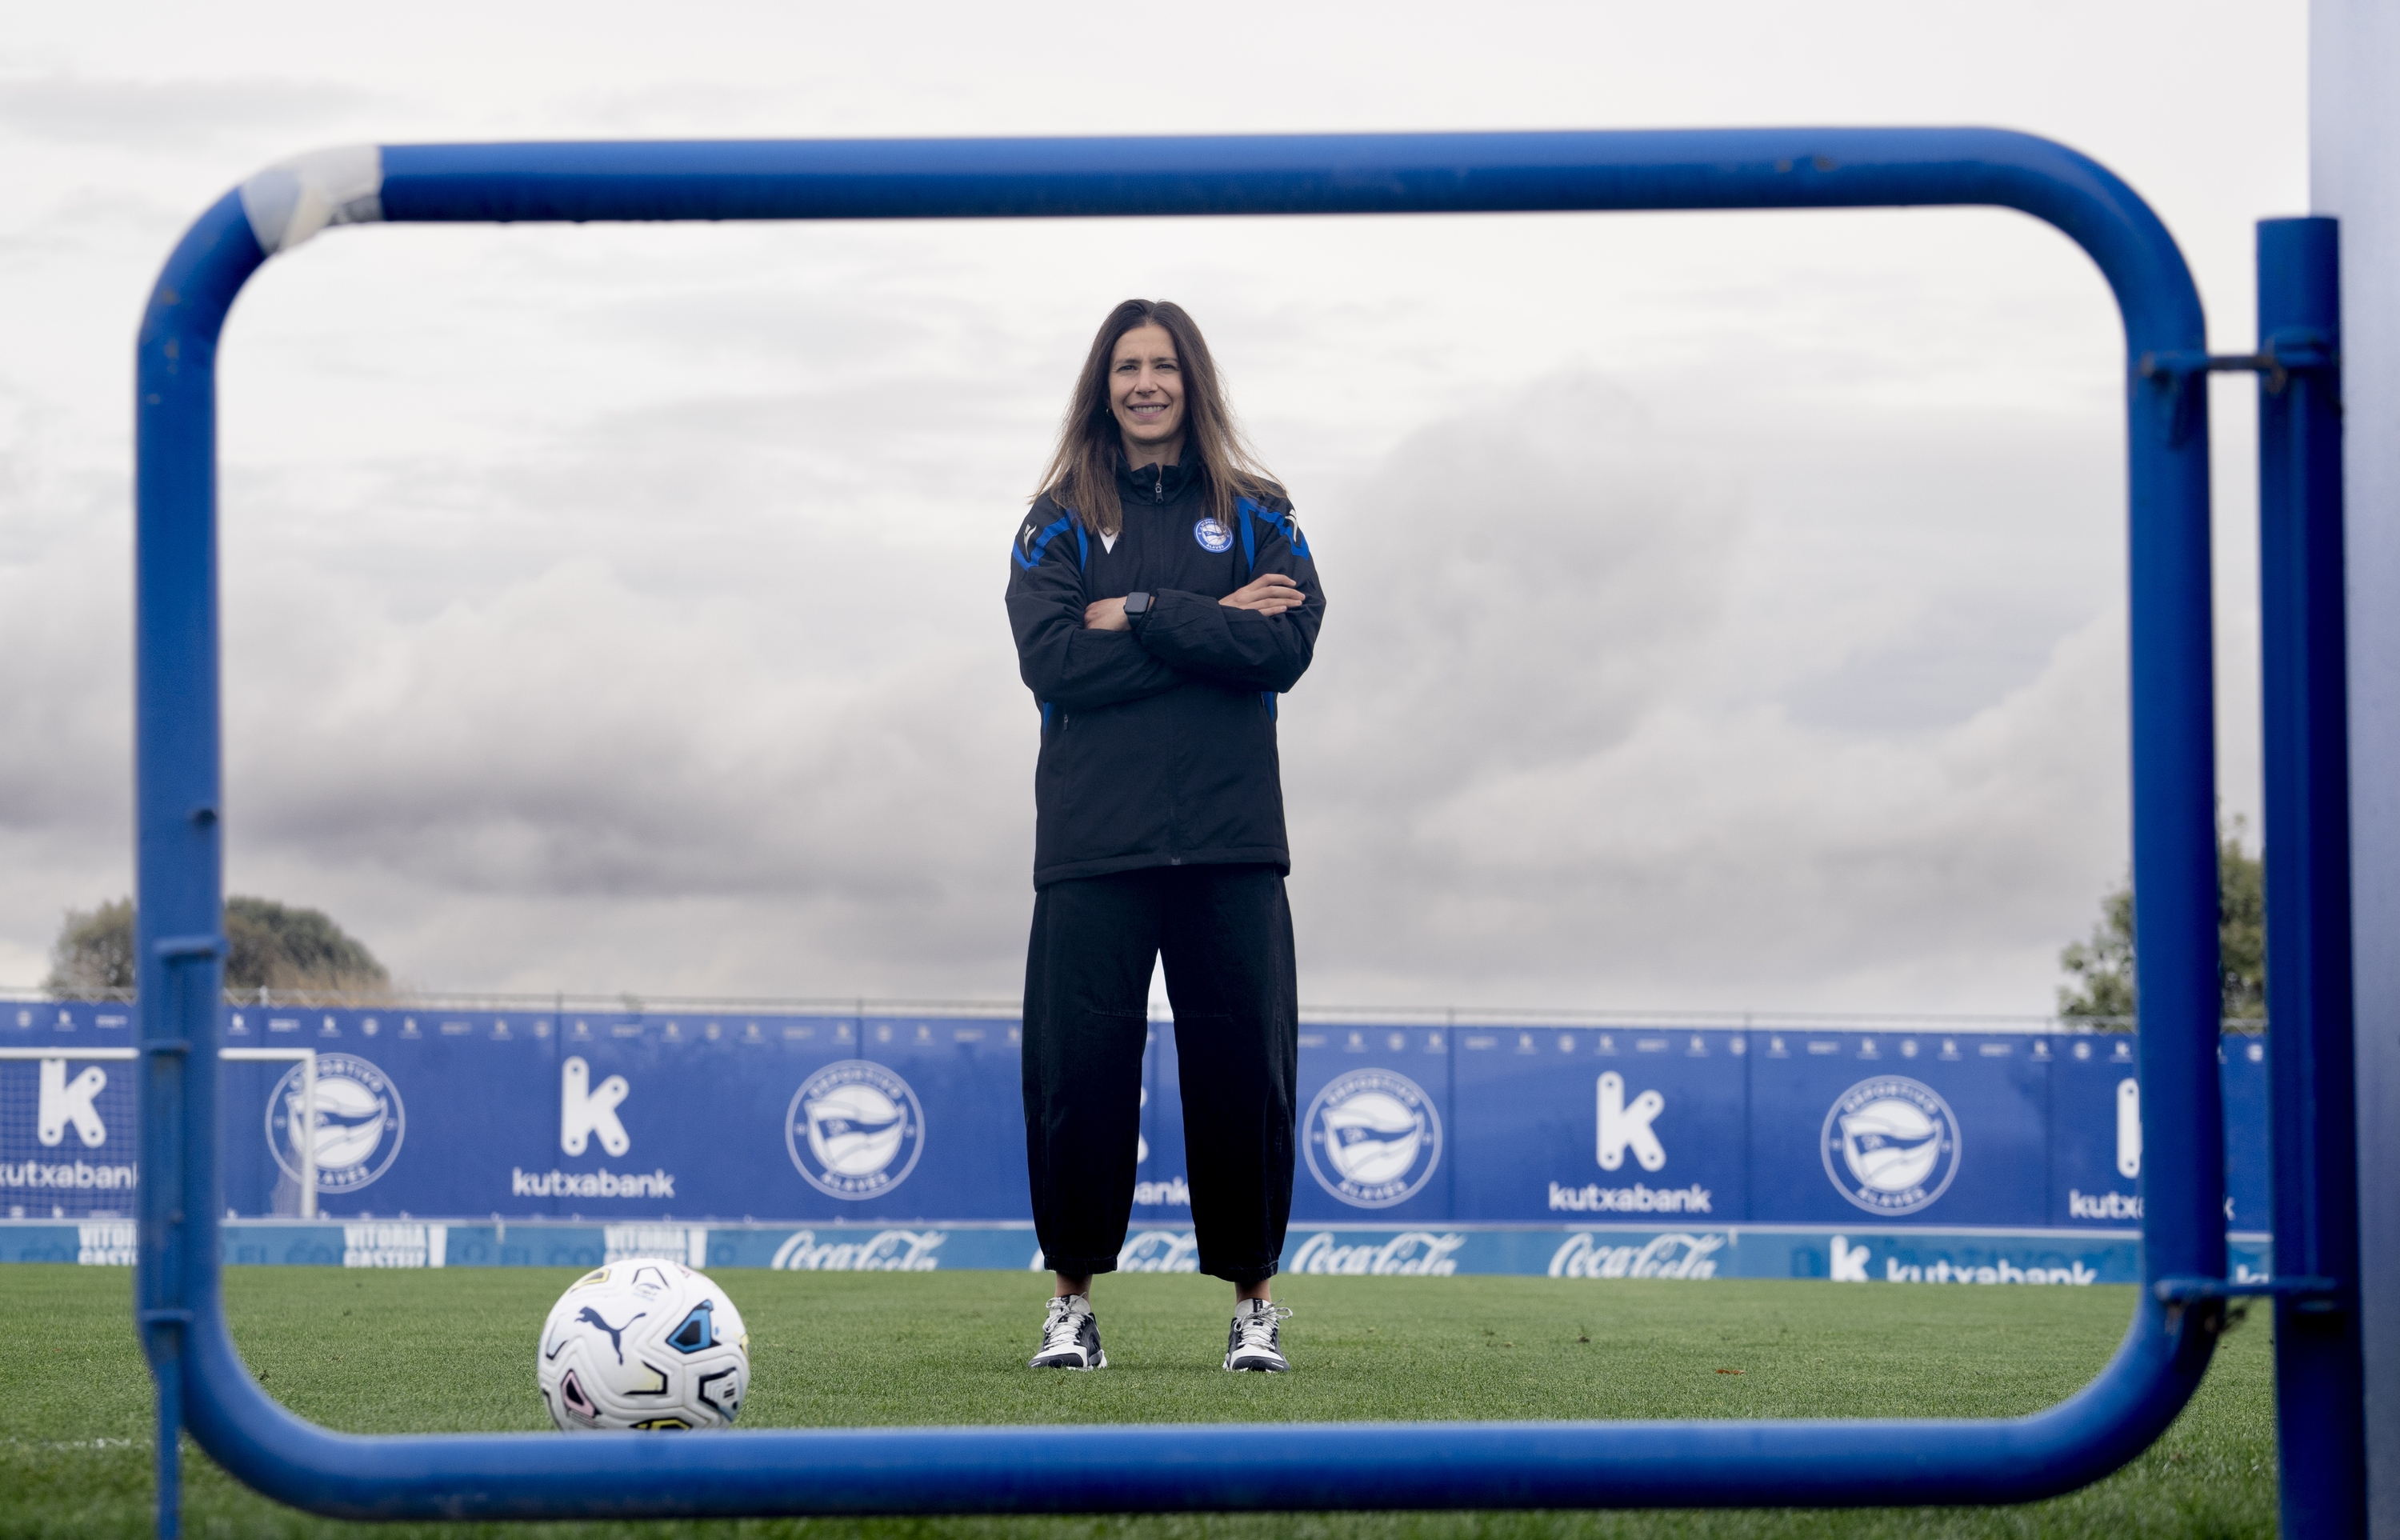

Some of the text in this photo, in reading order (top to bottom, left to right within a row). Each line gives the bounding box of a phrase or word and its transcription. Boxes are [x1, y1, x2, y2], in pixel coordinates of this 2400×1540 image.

[512, 1166, 675, 1198] kutxabank
[1548, 1182, 1712, 1213] kutxabank
[771, 1230, 949, 1270] Coca-Cola
[1289, 1232, 1467, 1275] Coca-Cola
[1548, 1233, 1726, 1278] Coca-Cola
